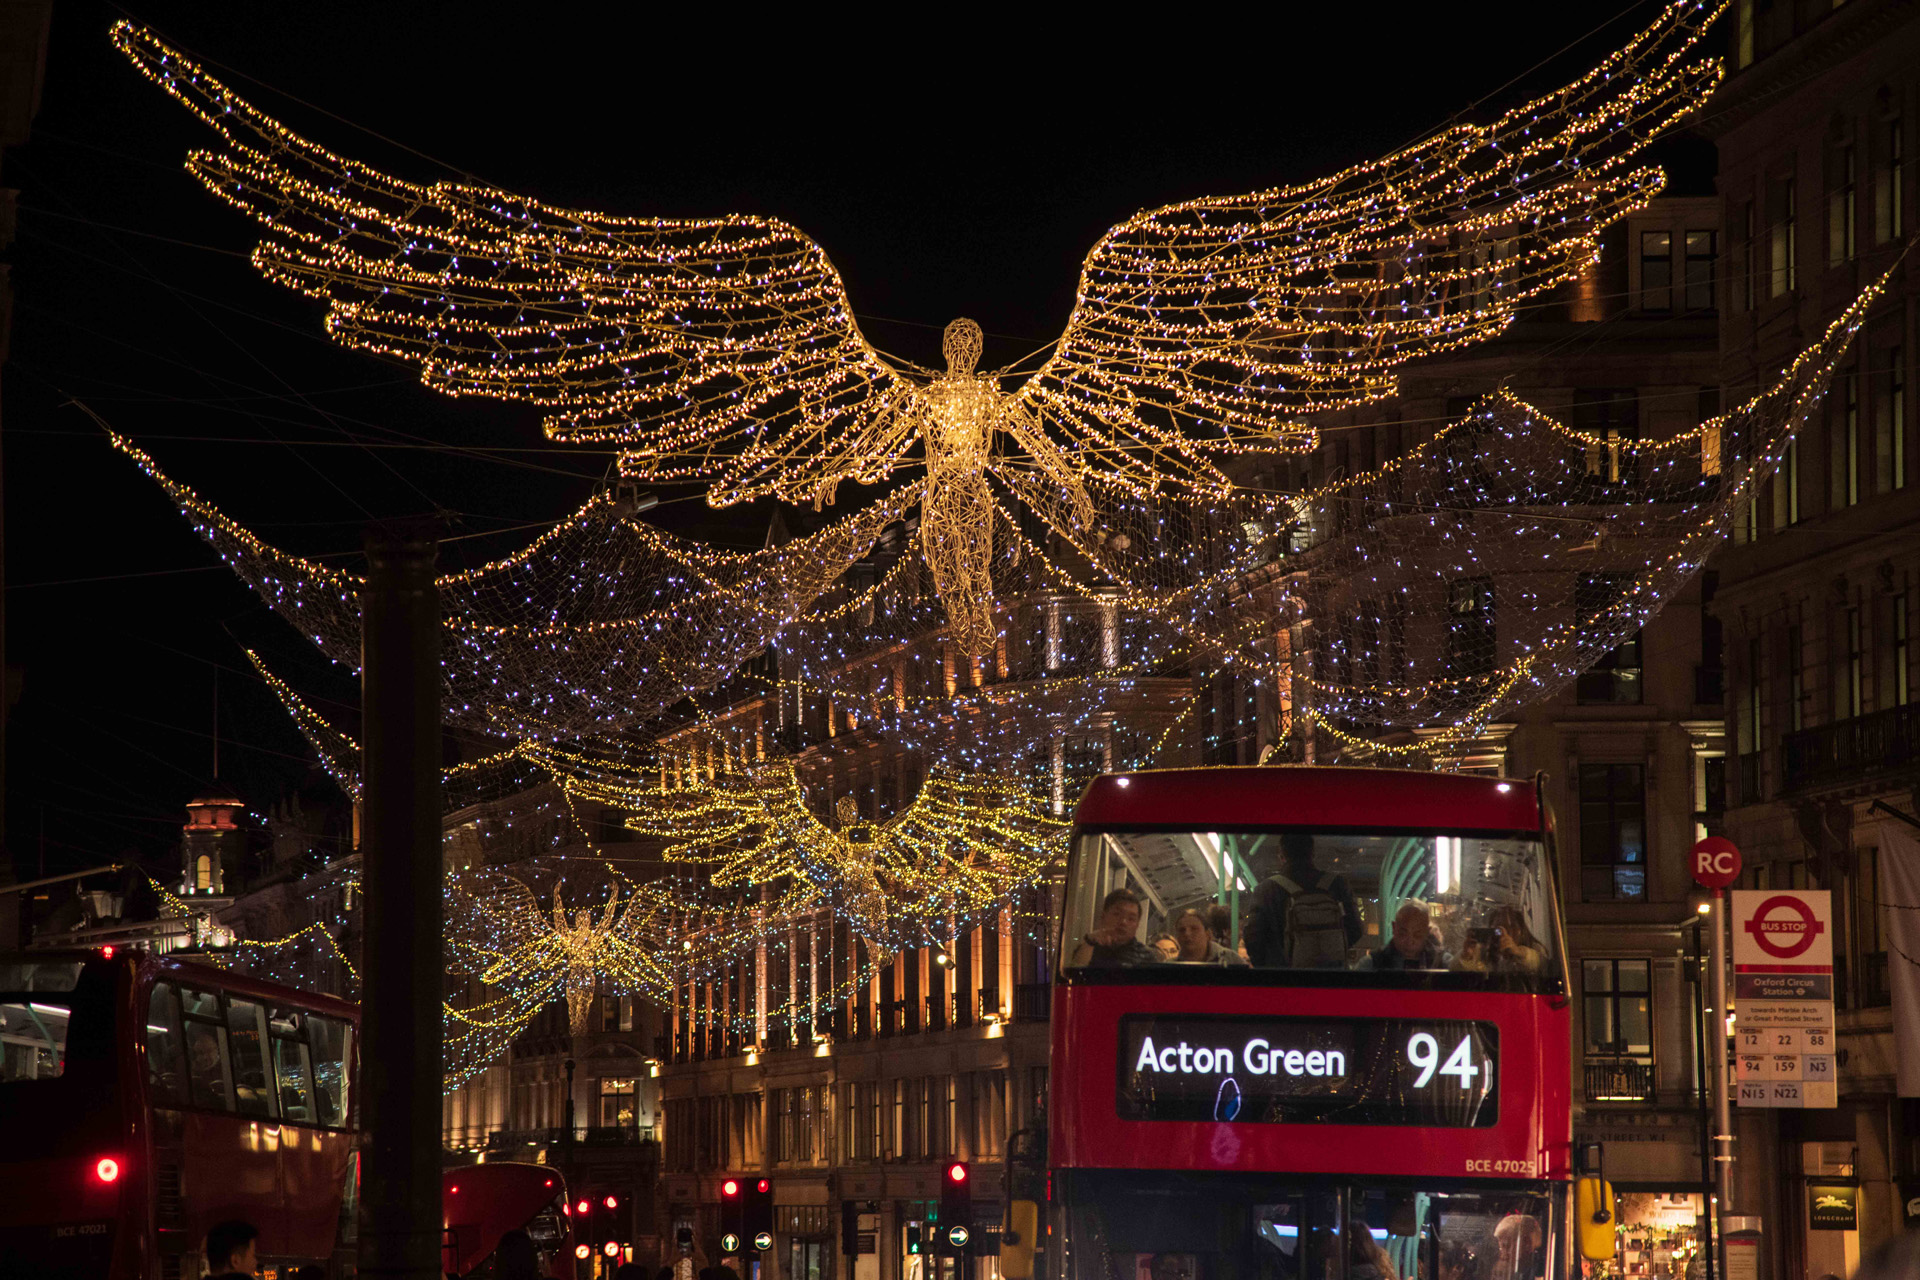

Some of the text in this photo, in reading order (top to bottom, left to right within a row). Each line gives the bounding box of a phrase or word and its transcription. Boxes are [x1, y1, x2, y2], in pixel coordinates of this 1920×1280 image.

[1697, 852, 1733, 874] RC
[1761, 923, 1807, 931] BUS STOP
[1754, 978, 1815, 987] Oxford Circus
[1763, 988, 1794, 996] Station
[1746, 1035, 1758, 1045] 12
[1777, 1035, 1792, 1045] 22
[1810, 1036, 1824, 1046] 88
[1136, 1032, 1478, 1089] Acton Green 94
[1745, 1062, 1760, 1072] 94
[1775, 1062, 1795, 1072] 159
[1810, 1062, 1827, 1072] N3
[1742, 1089, 1765, 1099] N15
[1774, 1089, 1798, 1099] N22
[1466, 1160, 1535, 1173] BCE 47025
